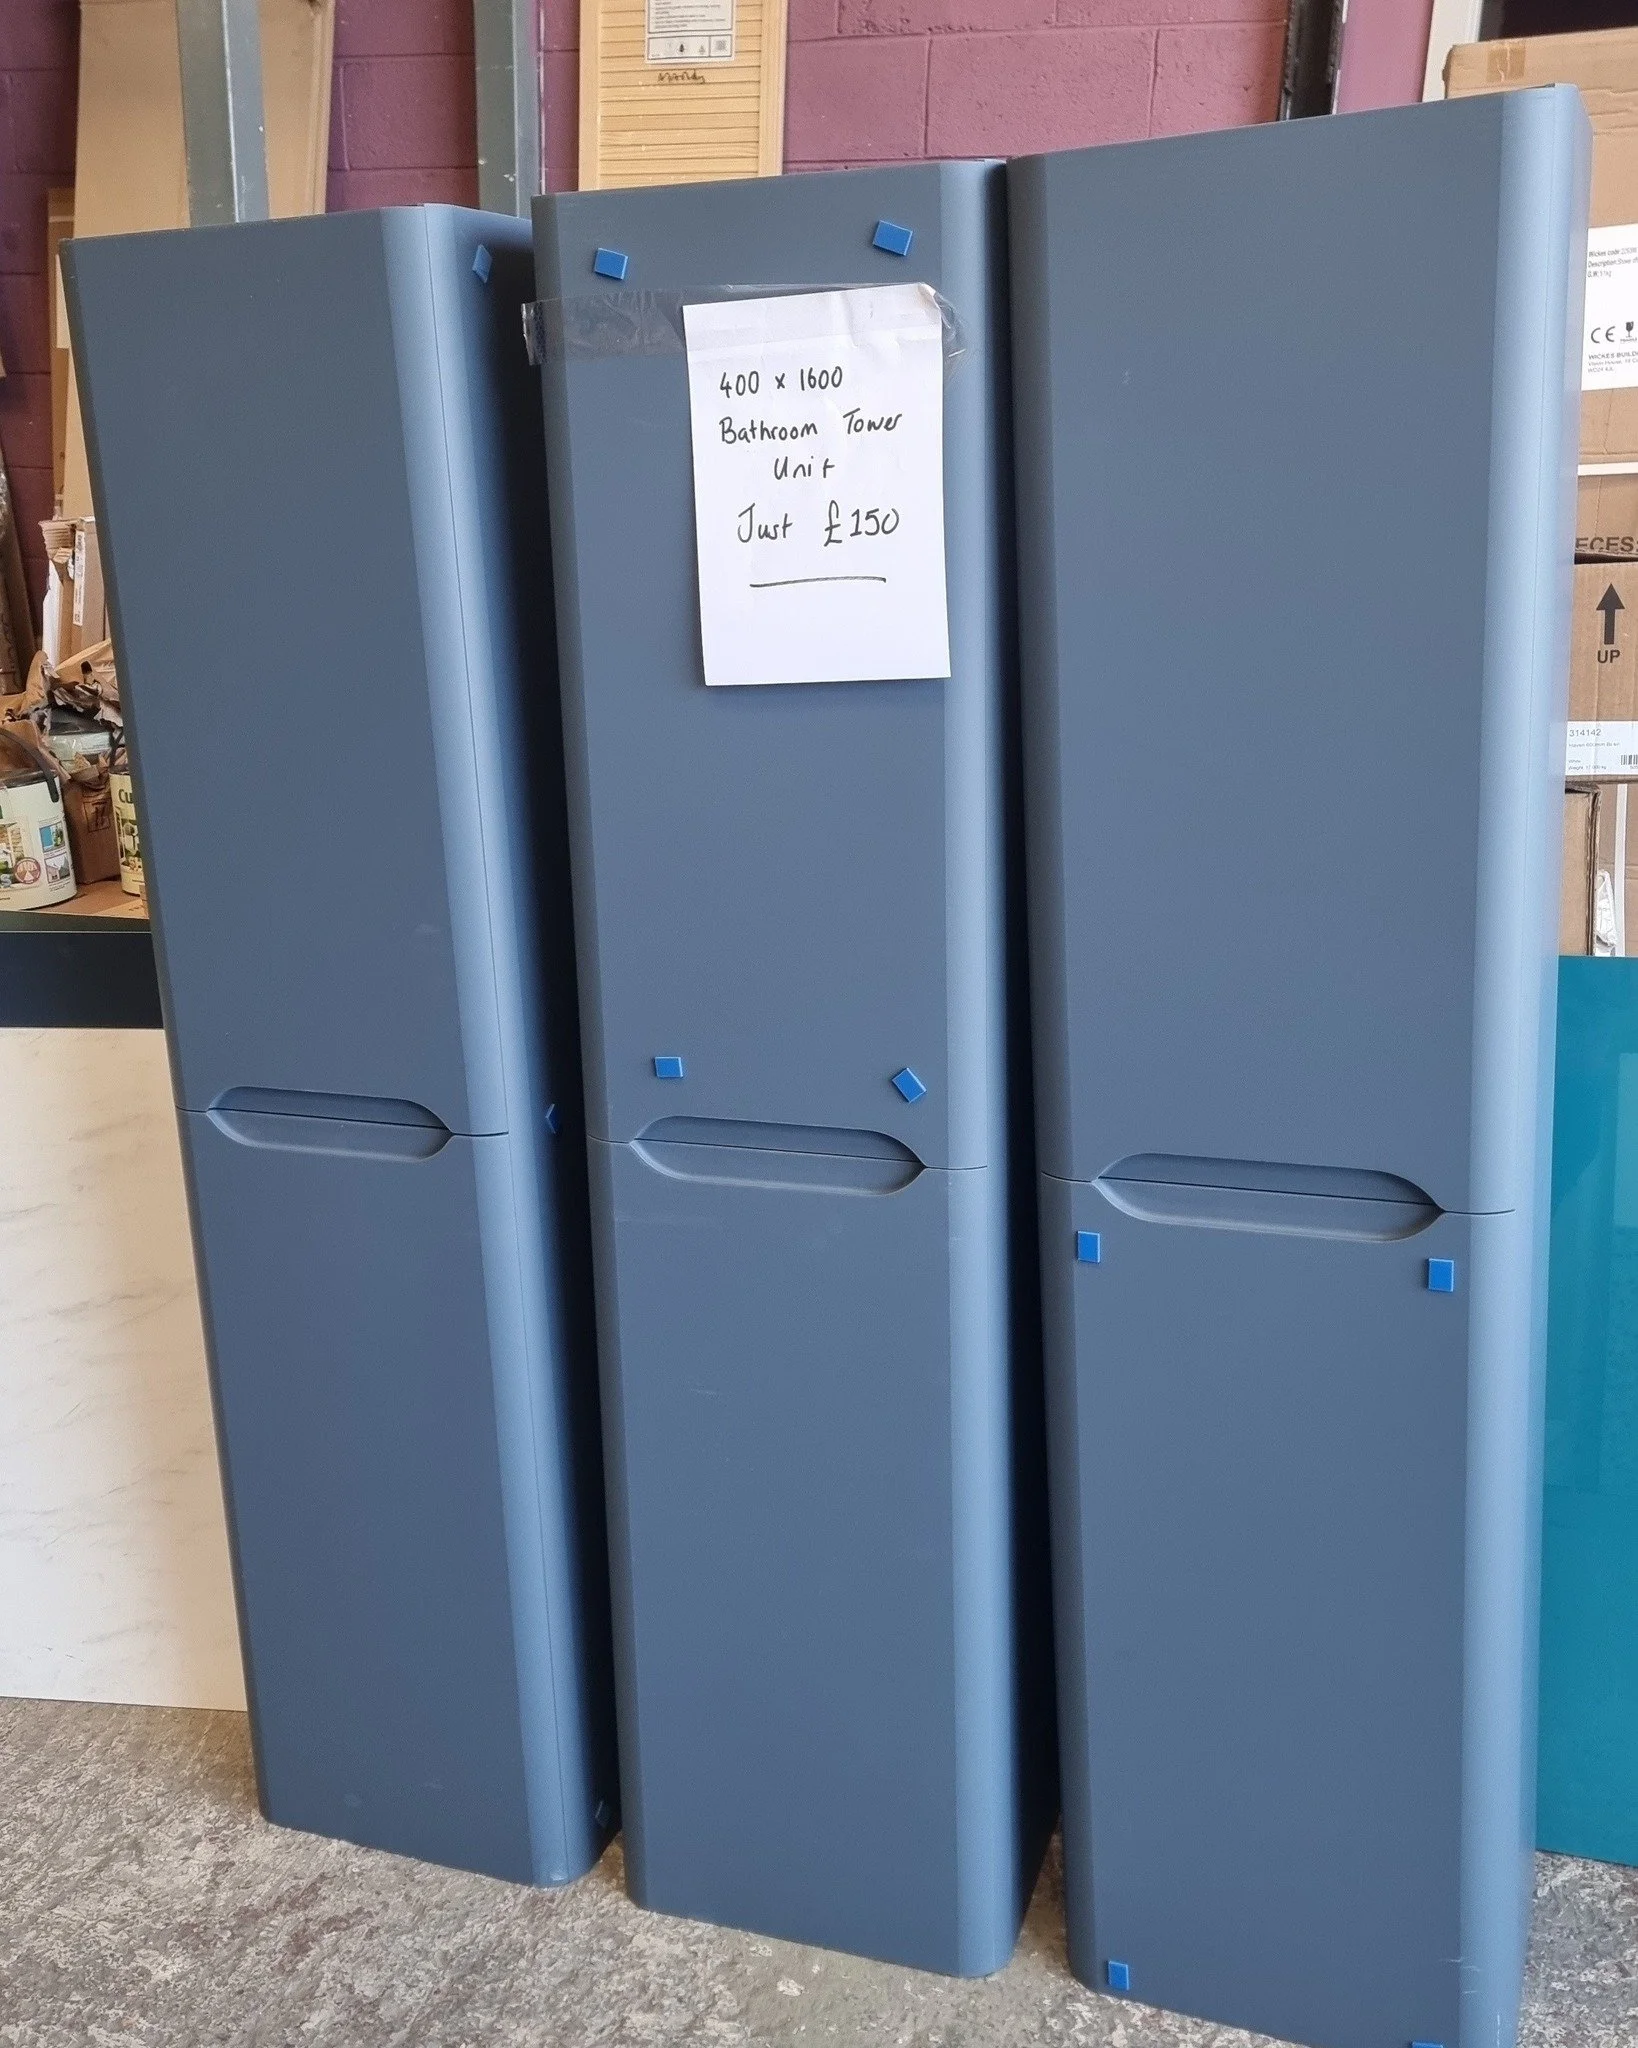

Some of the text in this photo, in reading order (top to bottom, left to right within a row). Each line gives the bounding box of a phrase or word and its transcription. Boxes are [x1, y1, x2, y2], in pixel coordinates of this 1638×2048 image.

[719, 366, 843, 399] 400 x 1600
[718, 407, 903, 445] Bathroom Tower
[773, 455, 836, 481] Unit
[737, 502, 793, 543] Just
[823, 499, 900, 547] £150
[1575, 536, 1638, 552] ECES
[1597, 649, 1621, 664] UP
[1569, 729, 1601, 737] 314142
